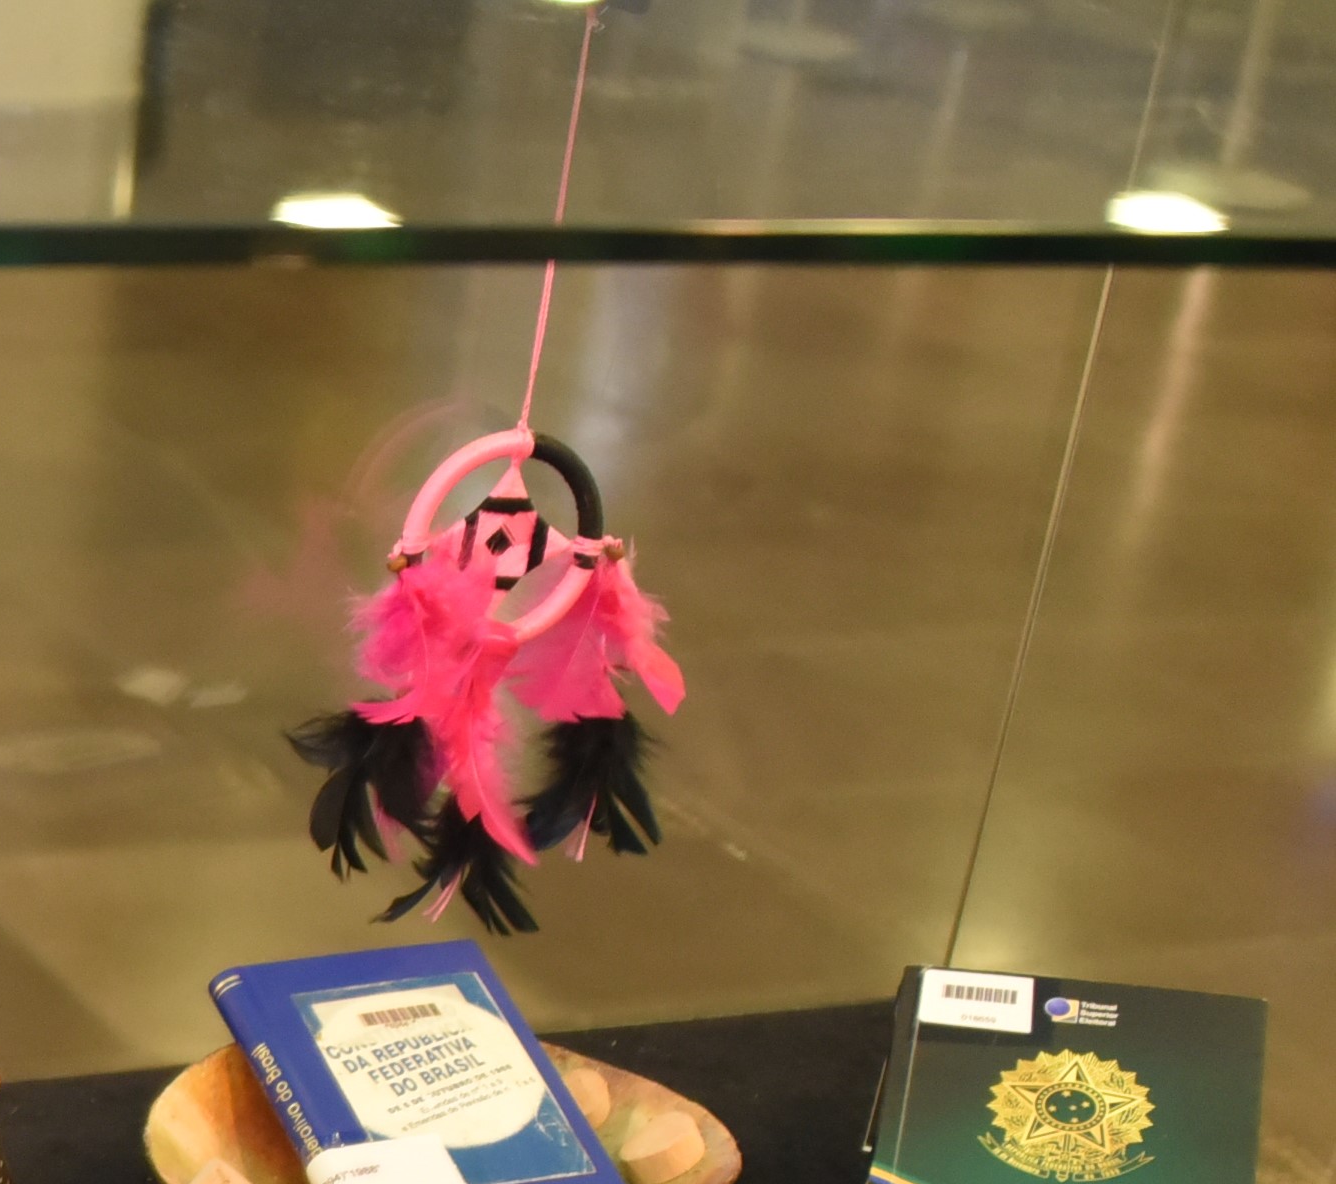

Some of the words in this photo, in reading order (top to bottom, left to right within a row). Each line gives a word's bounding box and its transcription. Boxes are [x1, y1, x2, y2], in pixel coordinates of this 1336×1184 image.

[251, 1042, 281, 1085] Brasil
[342, 1055, 372, 1074] DA
[367, 1036, 478, 1084] FEDERATIVA
[390, 1077, 418, 1097] DO
[419, 1053, 486, 1086] BRASIL
[427, 1078, 473, 1098] UTUBRO
